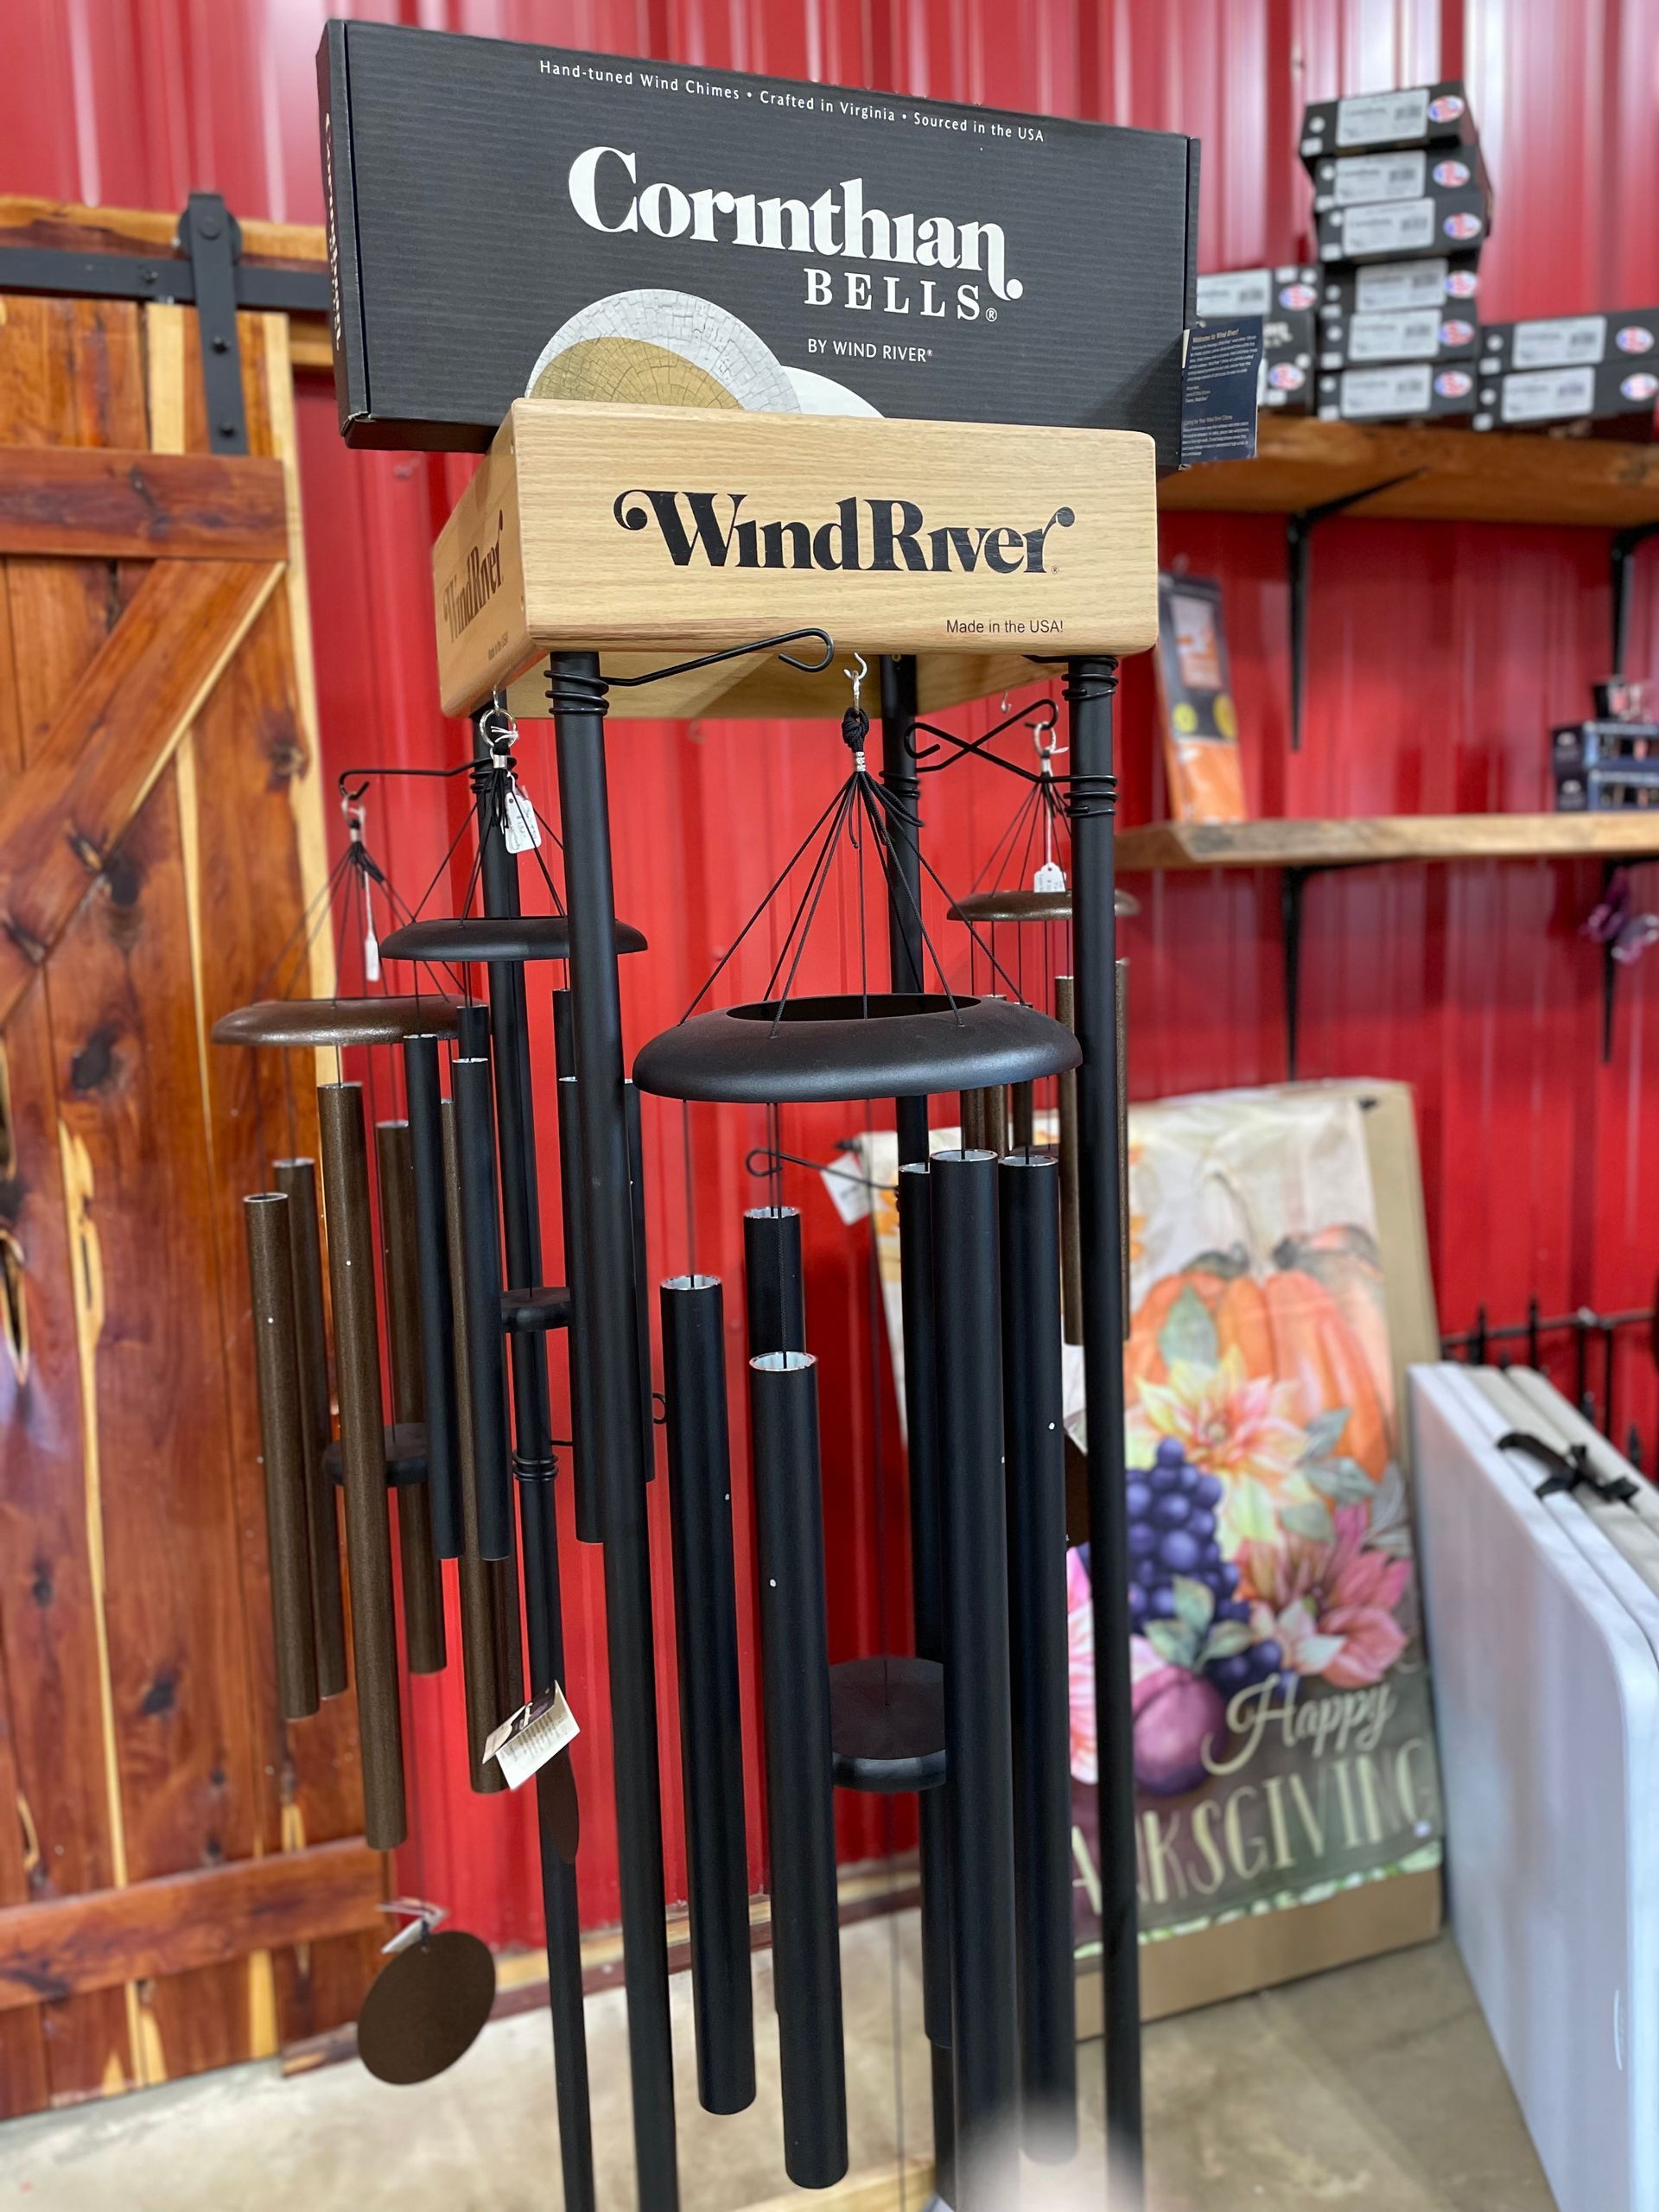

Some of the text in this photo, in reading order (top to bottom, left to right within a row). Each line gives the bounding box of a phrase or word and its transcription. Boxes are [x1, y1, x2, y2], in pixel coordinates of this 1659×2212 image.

[539, 60, 1045, 143] Hand-tuned Wind Chimes Crafted in Virginia Sourced in the USA
[568, 145, 1024, 302] Corinthian
[807, 338, 827, 354] BY
[832, 340, 877, 359] WIND
[946, 620, 1064, 633] Made in the USA!
[1200, 1672, 1398, 1776] Happy
